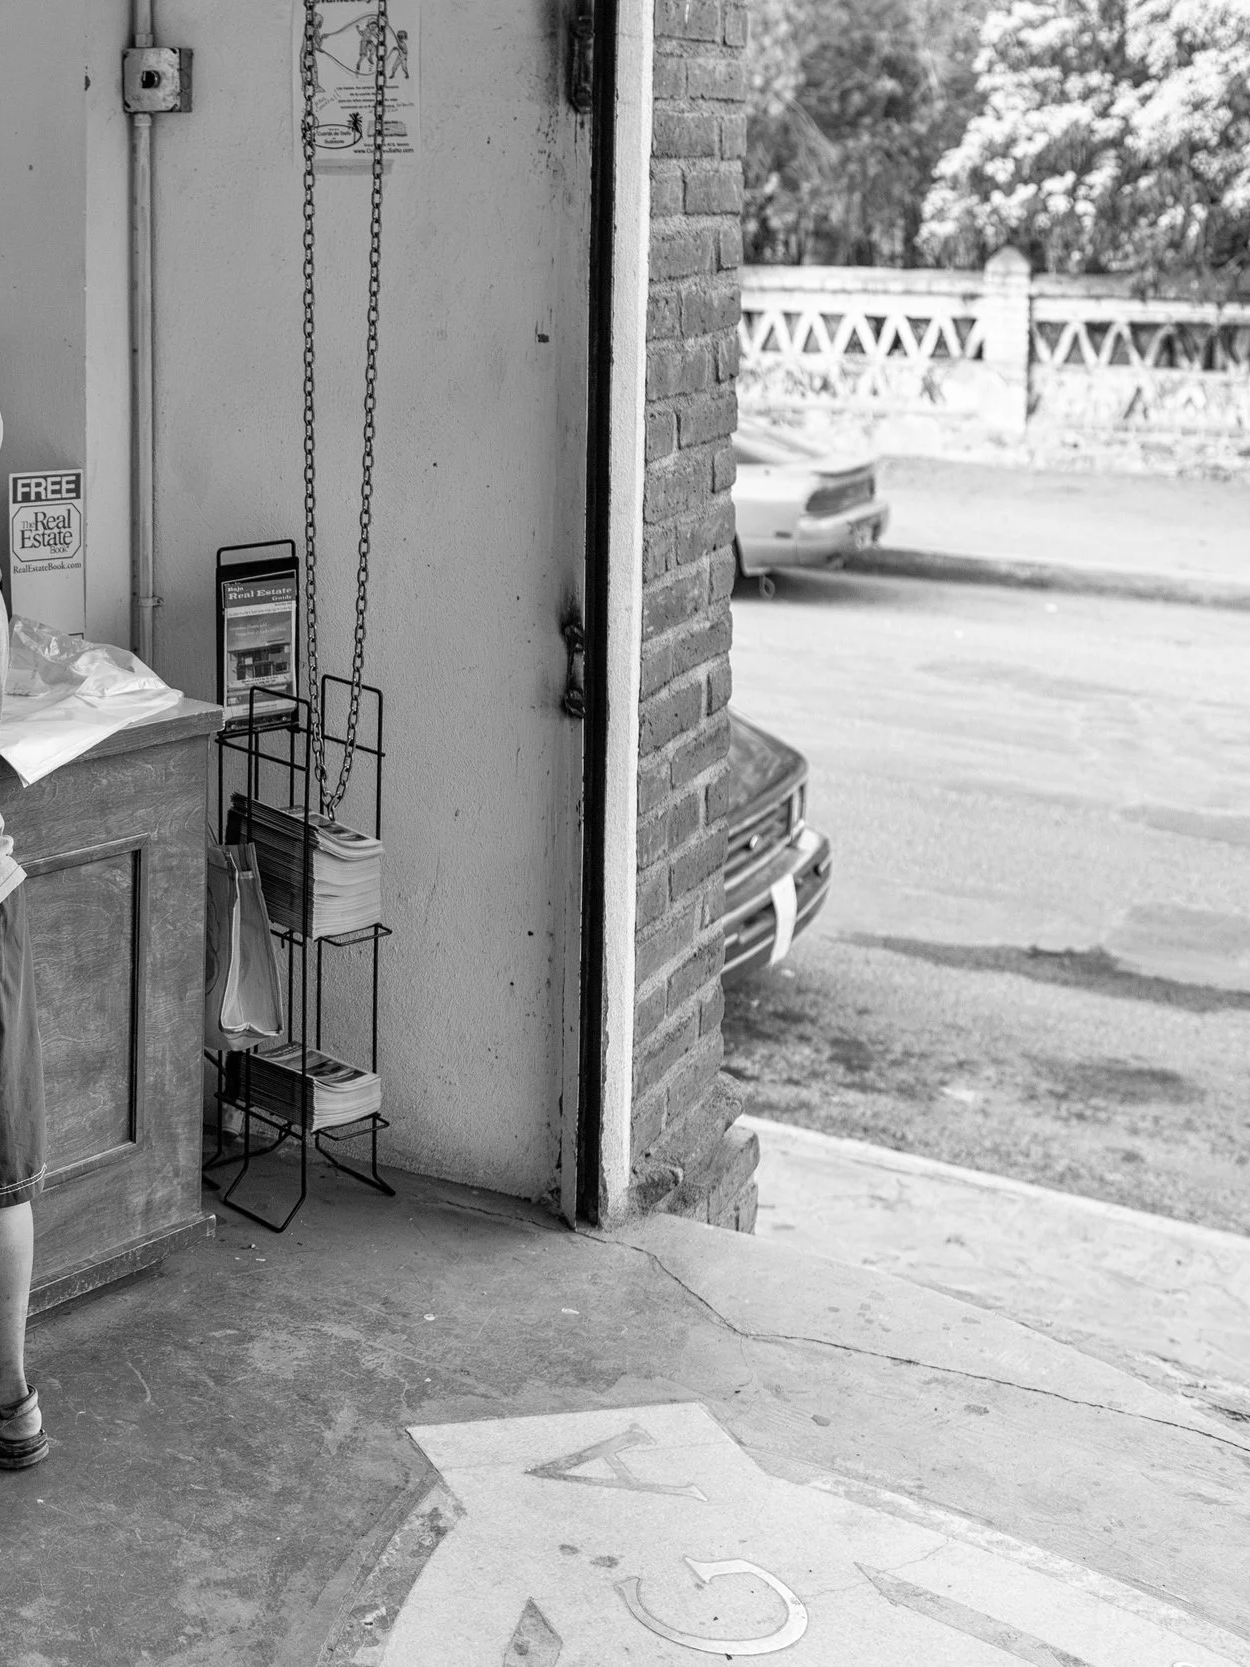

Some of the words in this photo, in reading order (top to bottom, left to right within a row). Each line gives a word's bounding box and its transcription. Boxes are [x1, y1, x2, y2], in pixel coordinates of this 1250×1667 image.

[17, 476, 76, 501] FREE
[22, 521, 35, 529] The
[34, 509, 72, 531] Real
[21, 529, 72, 549] Estate
[50, 546, 67, 554] Book
[13, 562, 82, 574] RealEstateBook.com
[228, 591, 254, 600] Real
[257, 588, 292, 597] Estate
